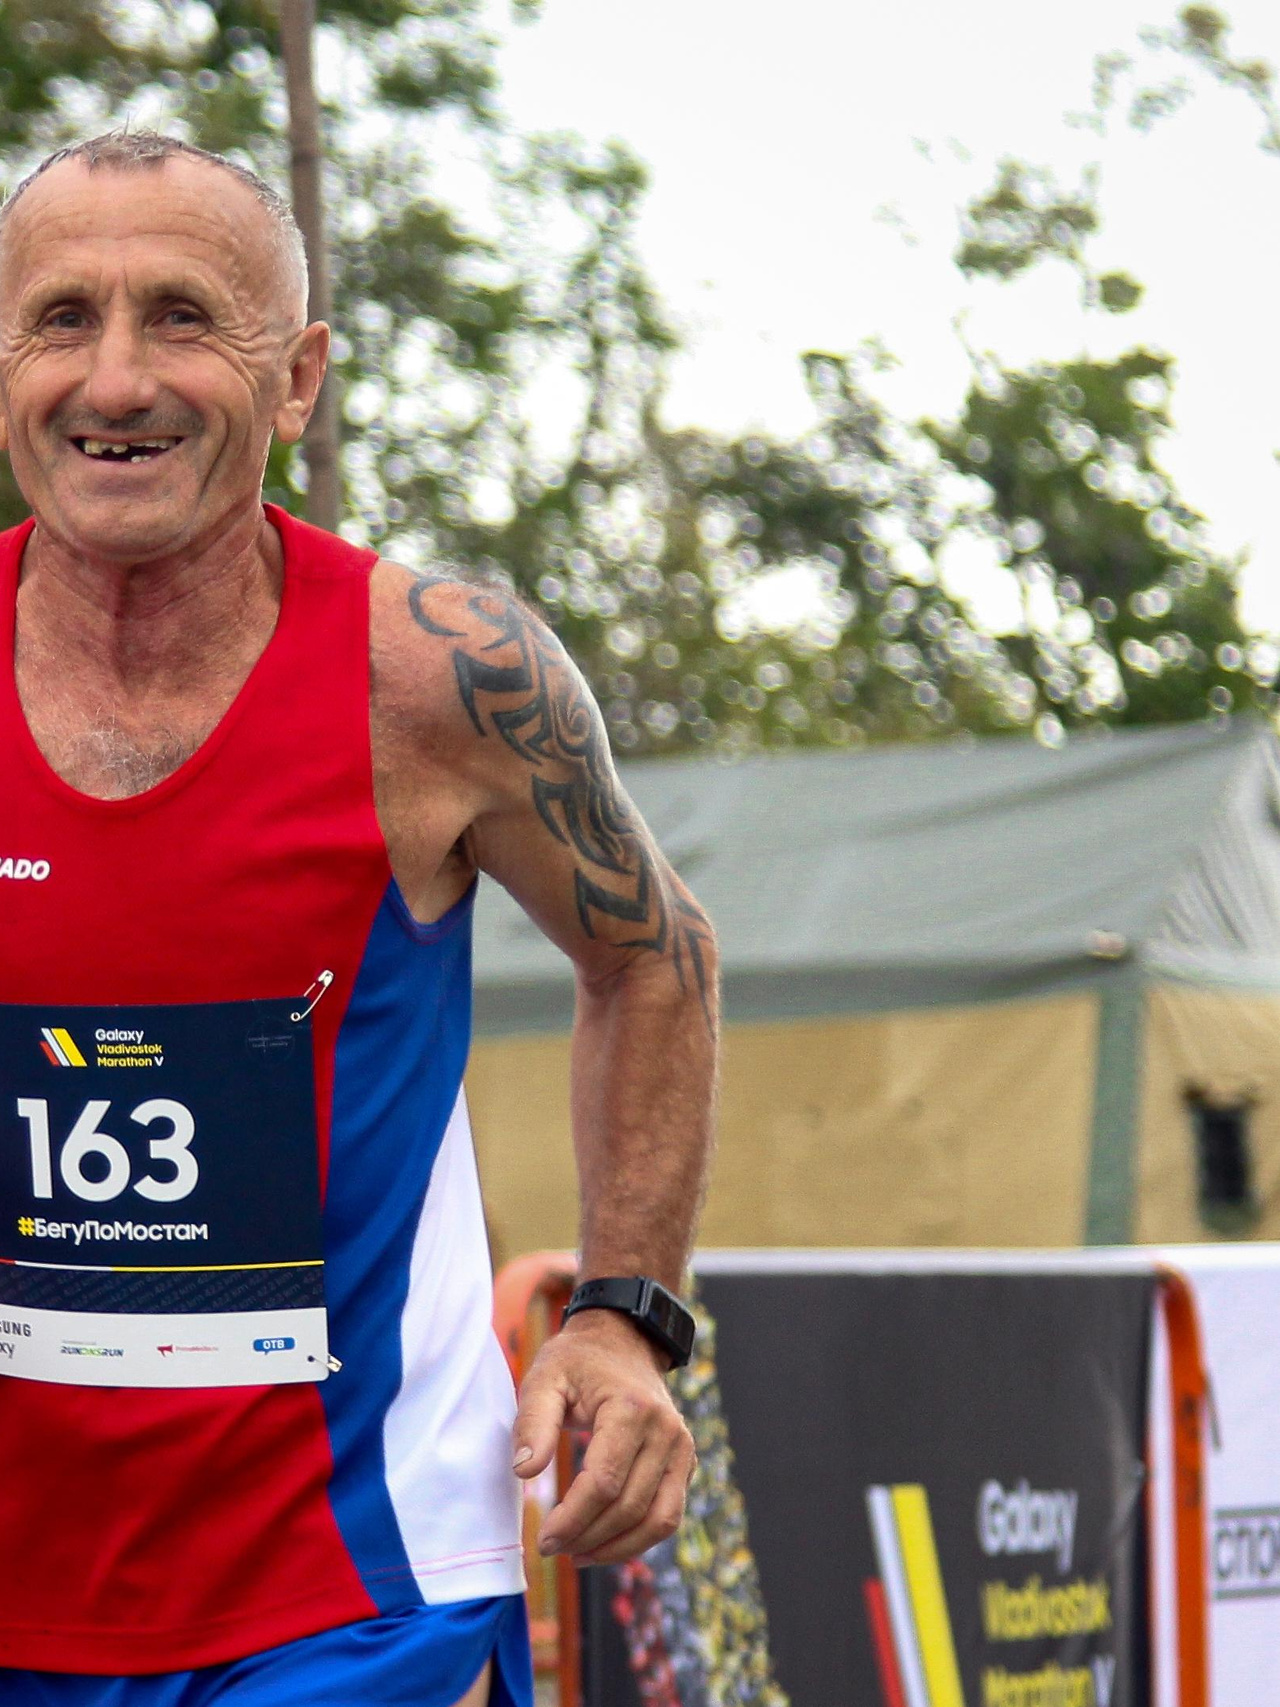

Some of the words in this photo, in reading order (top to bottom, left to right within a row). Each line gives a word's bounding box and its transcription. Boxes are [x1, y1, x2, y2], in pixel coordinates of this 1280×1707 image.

[95, 1028, 144, 1044] Galaxy
[97, 1043, 163, 1055] Vladivostok
[97, 1056, 153, 1067] Marathon
[154, 1056, 164, 1067] V
[17, 1098, 199, 1202] 163
[18, 1216, 209, 1246] #БегуПоМостам
[977, 1478, 1078, 1575] Galaxy
[1212, 1524, 1280, 1580] СПО
